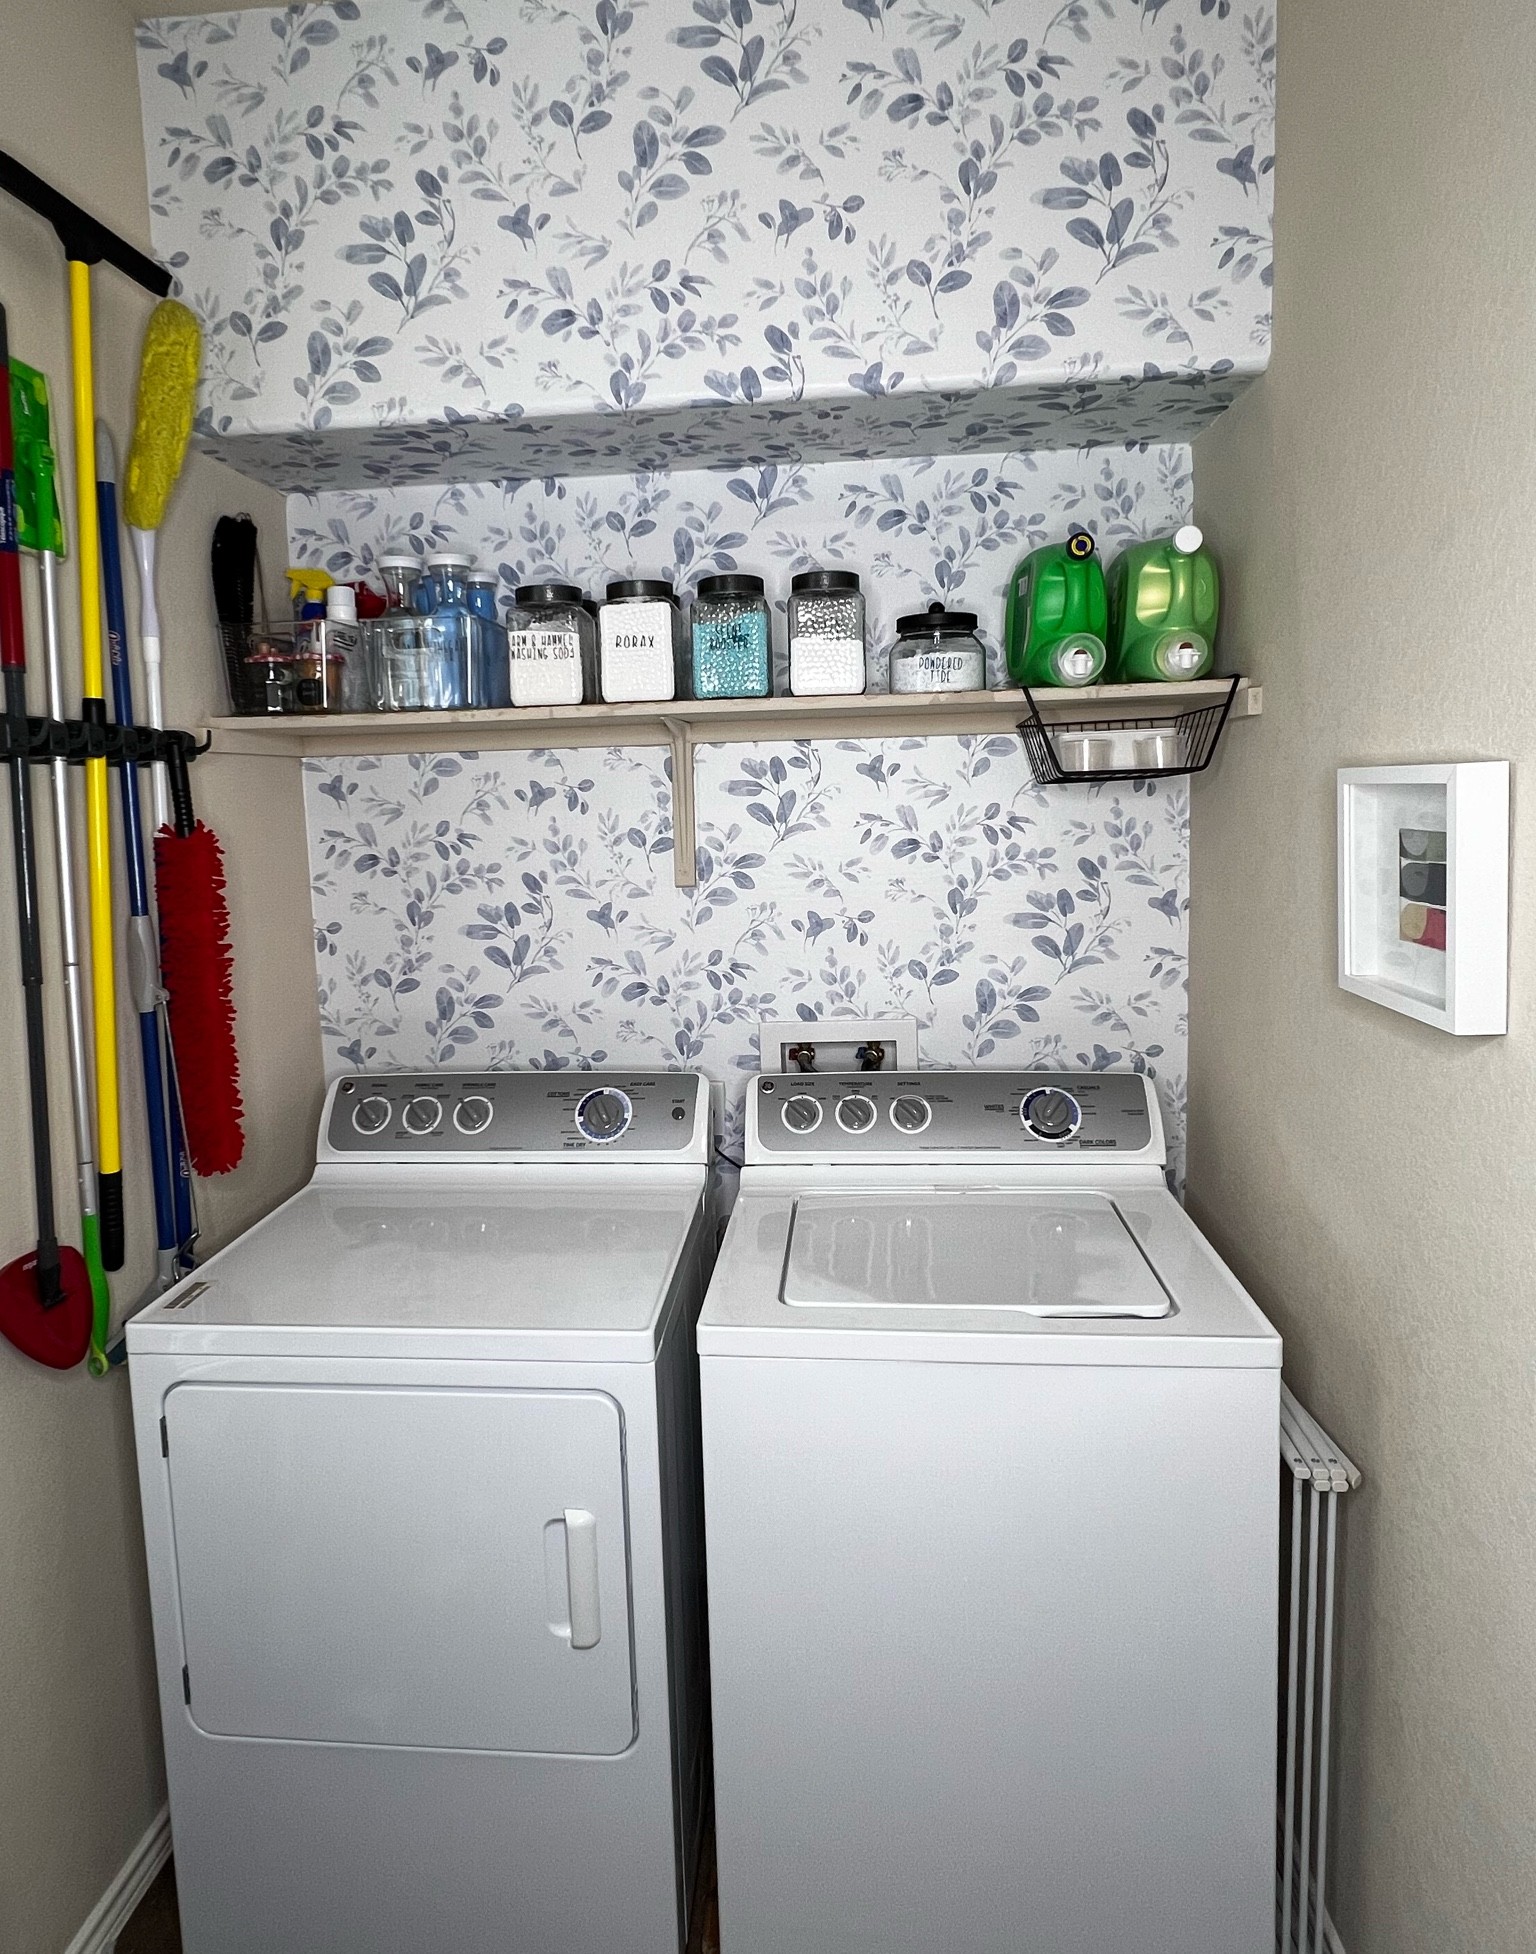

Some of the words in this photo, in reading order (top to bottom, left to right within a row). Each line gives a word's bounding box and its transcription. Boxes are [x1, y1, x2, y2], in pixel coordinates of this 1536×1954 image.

[511, 634, 527, 647] ARM
[510, 646, 549, 661] WASHING
[553, 646, 576, 660] SODA
[918, 656, 963, 670] POWDERED
[930, 670, 951, 683] TIDE
